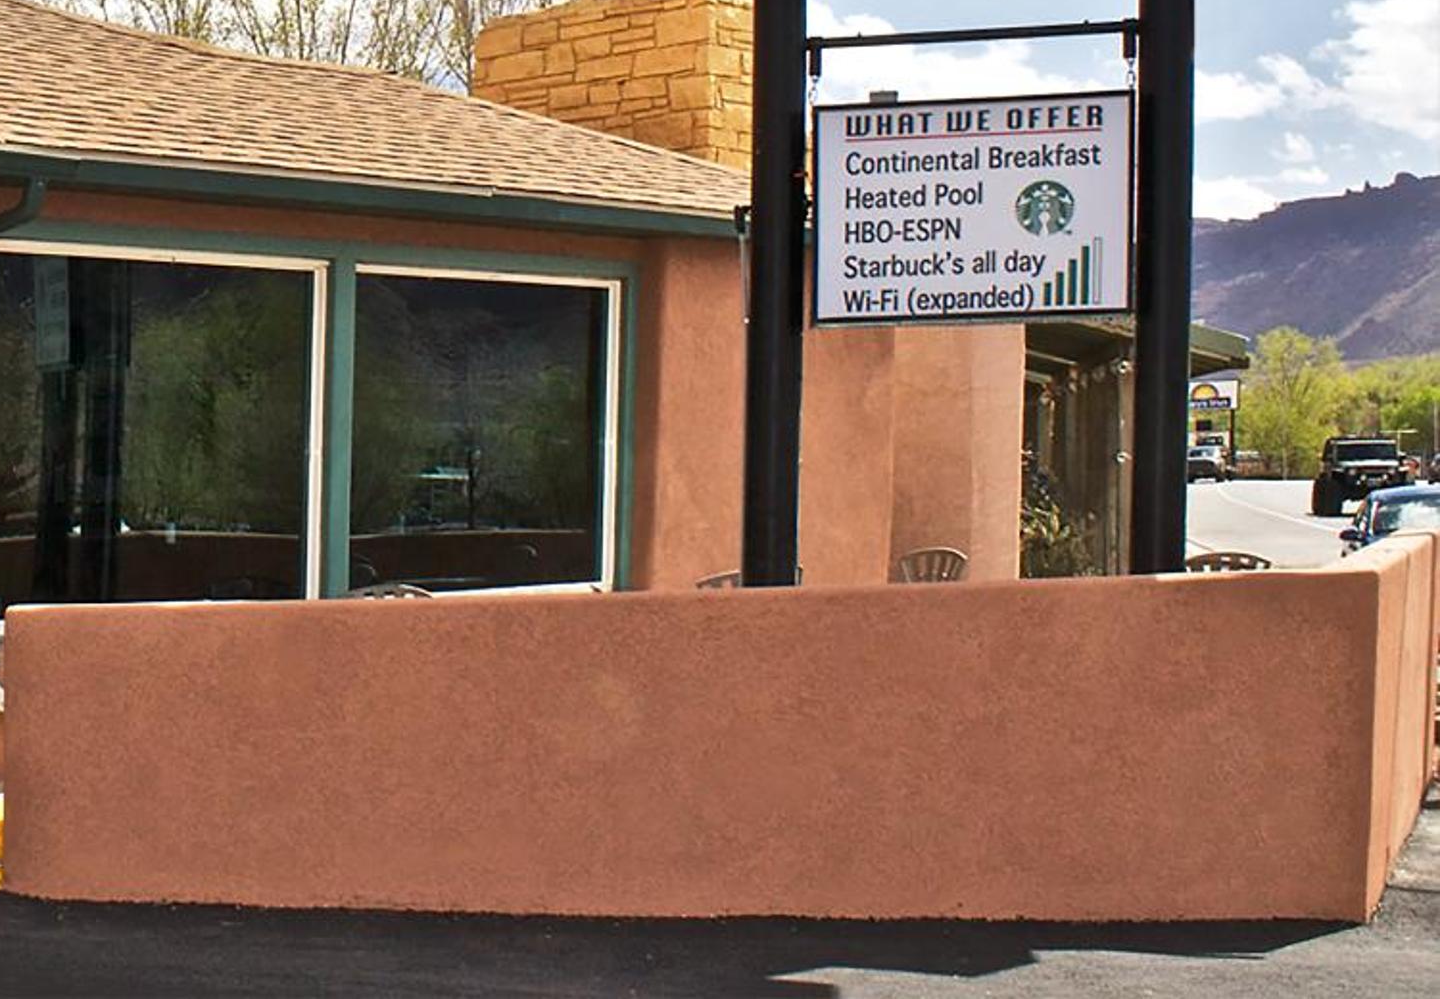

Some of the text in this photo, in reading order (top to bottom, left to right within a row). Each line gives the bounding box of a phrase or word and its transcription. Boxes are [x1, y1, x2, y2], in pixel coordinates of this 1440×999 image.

[845, 105, 1104, 137] WHAT WE OFFER
[844, 143, 1102, 175] Continental Breakfast
[844, 182, 984, 210] Heated Pool
[844, 218, 962, 244] HBO-ESPN
[843, 249, 1047, 279] Starbuck's all day
[844, 284, 1035, 314] Wi-Fi (expanded)
